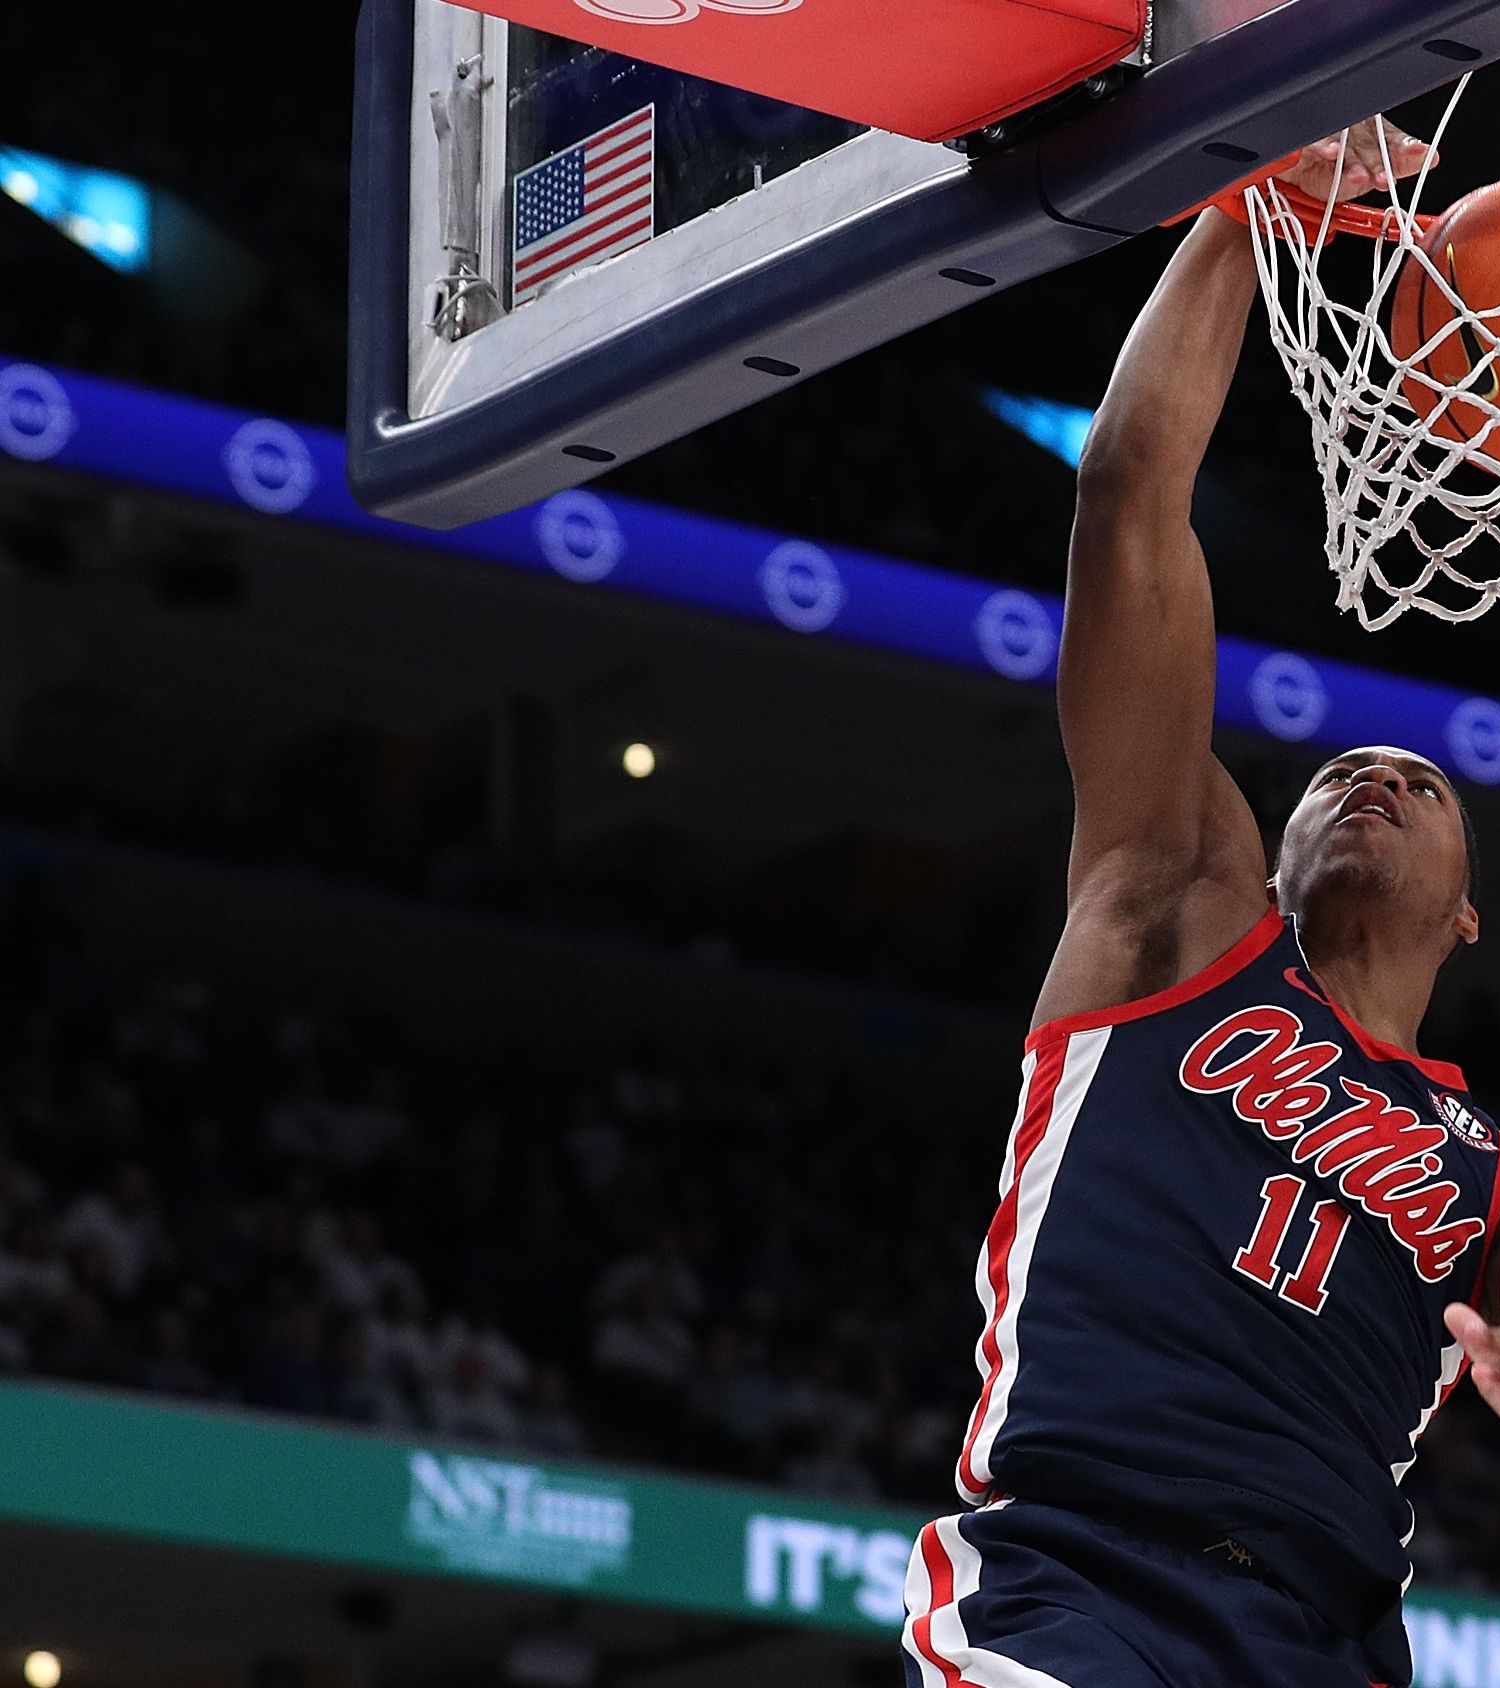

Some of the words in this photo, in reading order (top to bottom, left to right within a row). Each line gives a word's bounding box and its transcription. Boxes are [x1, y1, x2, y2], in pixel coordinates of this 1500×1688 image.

[1179, 1005, 1343, 1141] Ole
[1292, 1076, 1485, 1283] Miss
[1442, 1096, 1487, 1140] SEC
[1232, 1173, 1351, 1316] 11
[747, 1513, 913, 1624] IT'S
